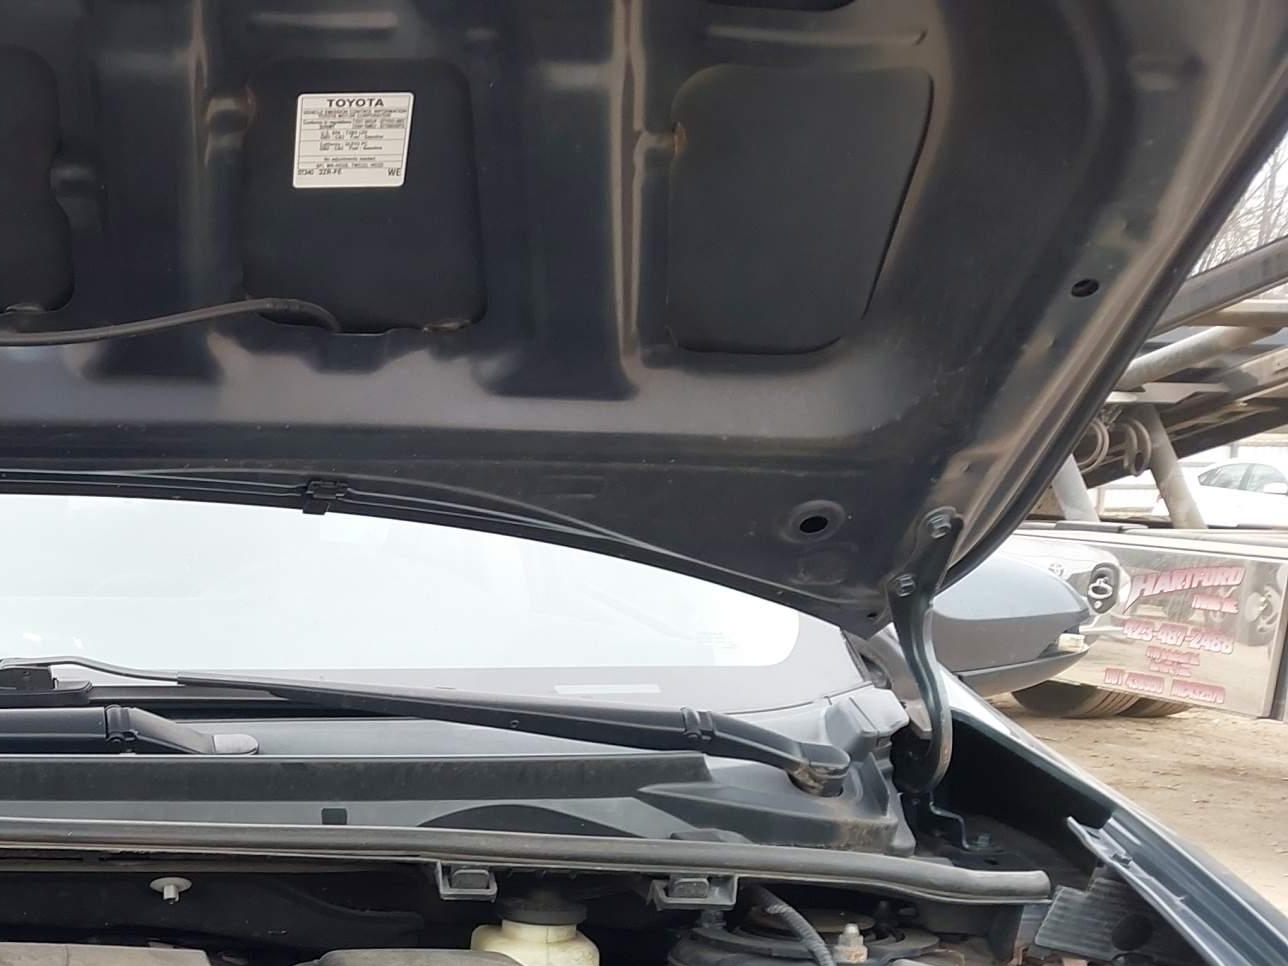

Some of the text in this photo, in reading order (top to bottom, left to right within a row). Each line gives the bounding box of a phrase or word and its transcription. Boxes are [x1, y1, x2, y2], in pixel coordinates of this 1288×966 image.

[327, 98, 384, 107] TOYOTA
[388, 168, 401, 176] WE
[1124, 567, 1245, 613] HARTFORD
